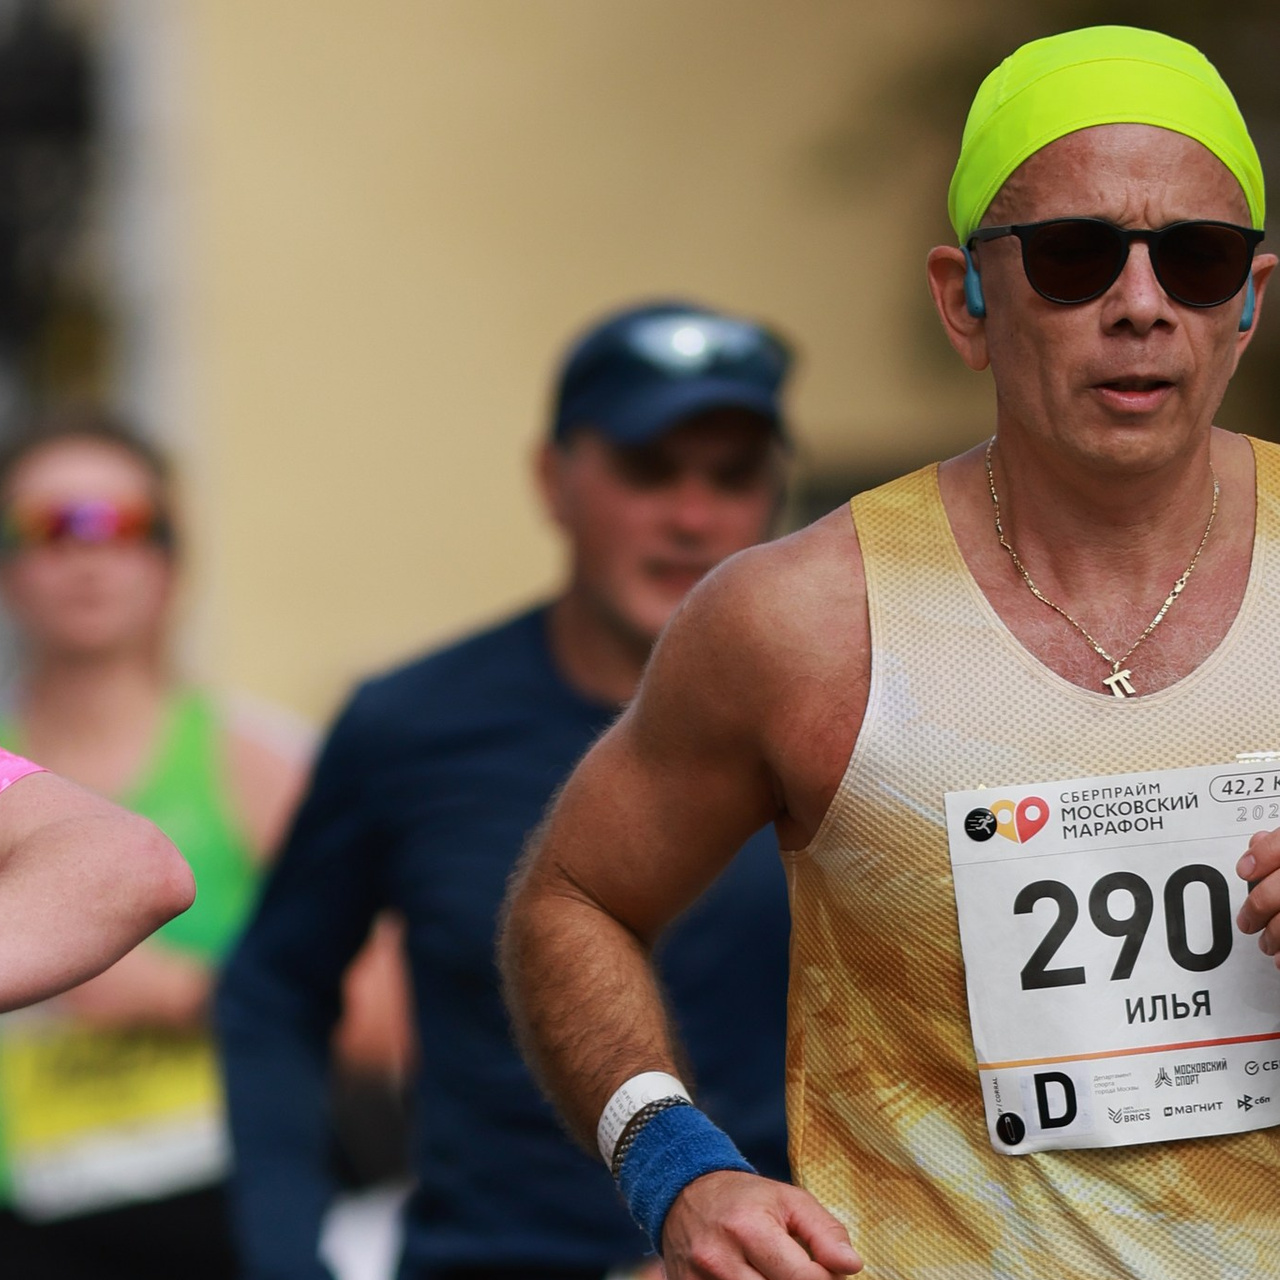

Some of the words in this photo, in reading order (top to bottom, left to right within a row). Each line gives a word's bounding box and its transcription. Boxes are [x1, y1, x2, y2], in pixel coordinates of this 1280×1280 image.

[1060, 783, 1161, 804] СБЕРПРАЙМ
[1222, 777, 1264, 796] 42,2
[1061, 792, 1199, 822] МОСКОВСКИЙ
[1063, 816, 1164, 839] МАРАФОН
[1013, 863, 1261, 991] 290
[1125, 989, 1212, 1025] ИЛЬЯ
[1174, 1058, 1228, 1075] МОСКОВСКИЙ
[1262, 1060, 1280, 1071] СБ
[1175, 1074, 1200, 1087] СПОРТ
[1033, 1071, 1078, 1130] D
[1123, 1112, 1151, 1123] BRICS
